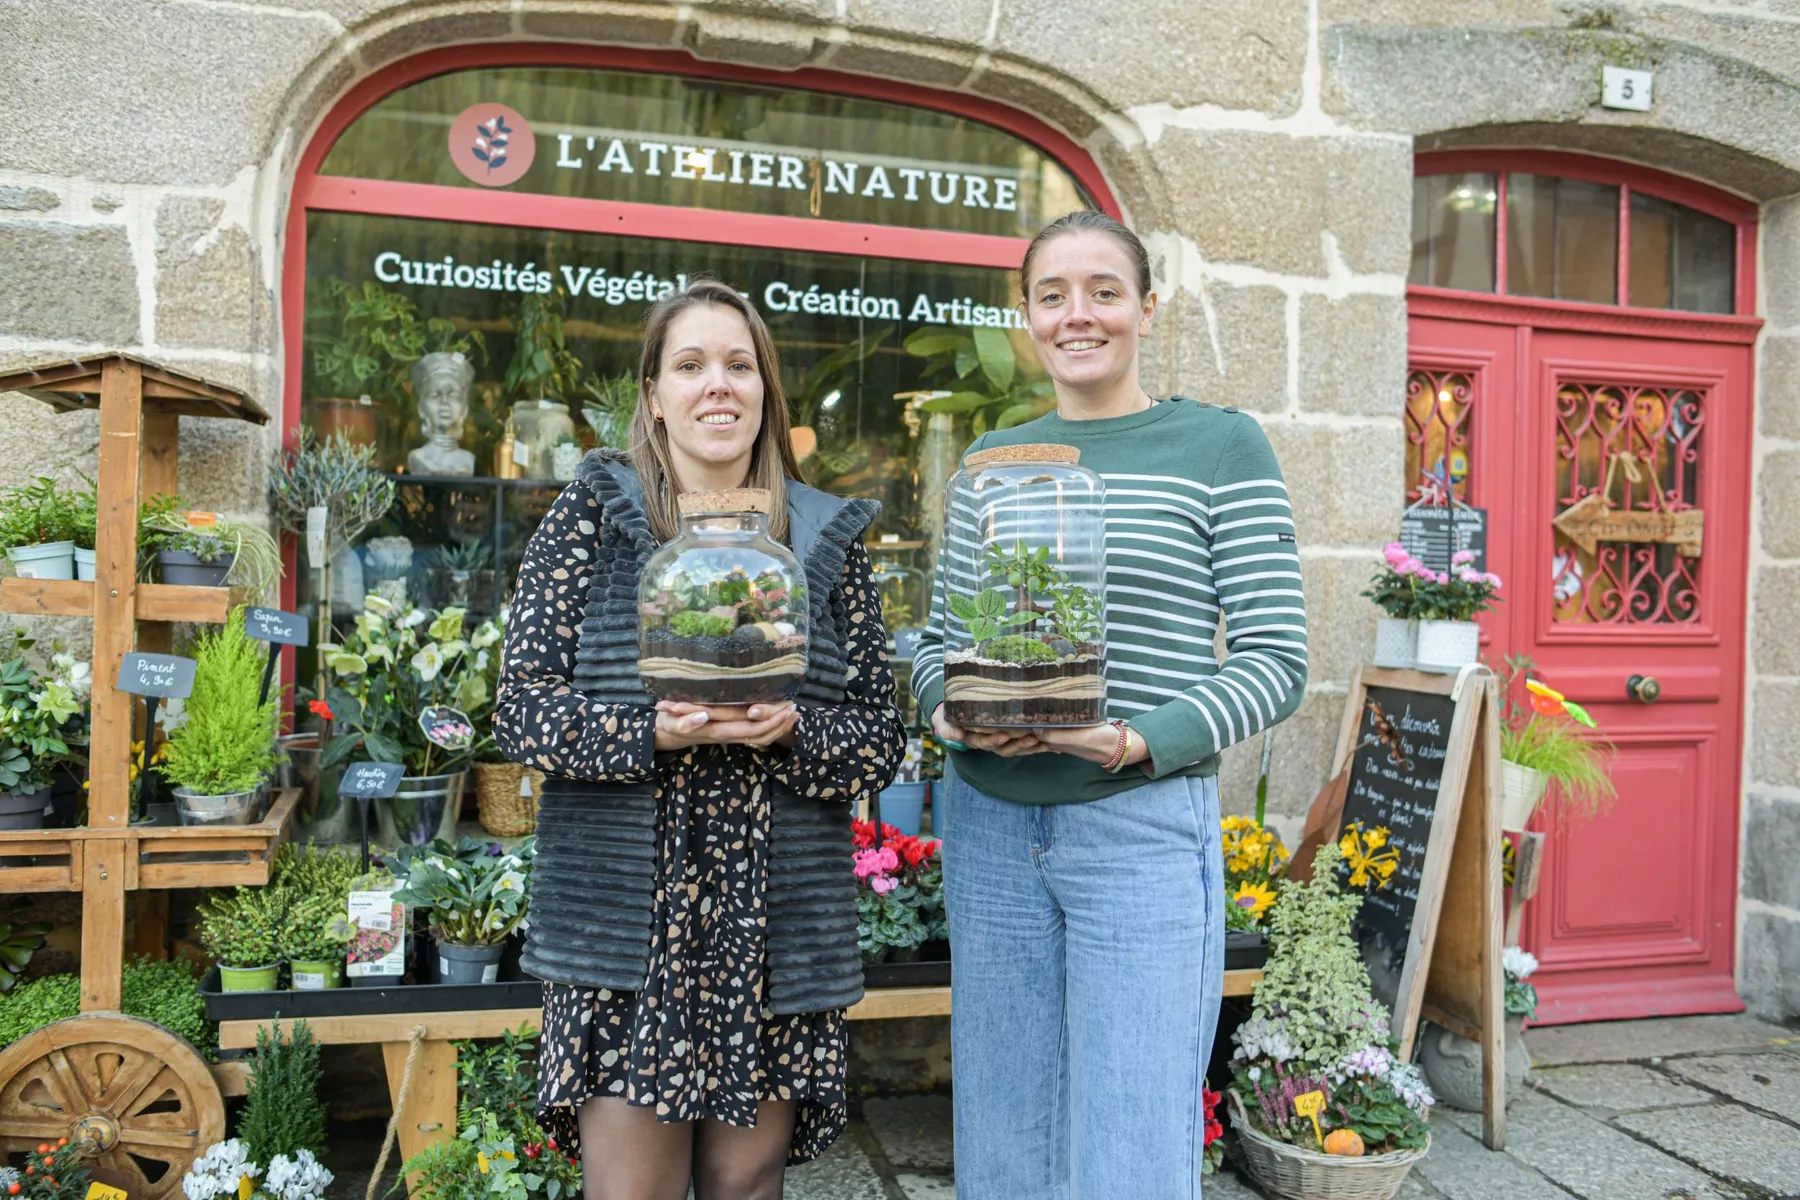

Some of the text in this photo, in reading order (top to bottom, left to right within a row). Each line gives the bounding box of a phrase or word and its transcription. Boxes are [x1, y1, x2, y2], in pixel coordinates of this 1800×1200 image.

[1622, 79, 1634, 100] 5
[556, 134, 1017, 211] L'ATELIER NATURE
[374, 251, 552, 294] Curiosités
[560, 265, 688, 305] Végétal
[764, 281, 902, 320] Création
[907, 293, 1029, 330] Artisan
[253, 608, 283, 624] Sapin
[137, 659, 176, 673] Piment
